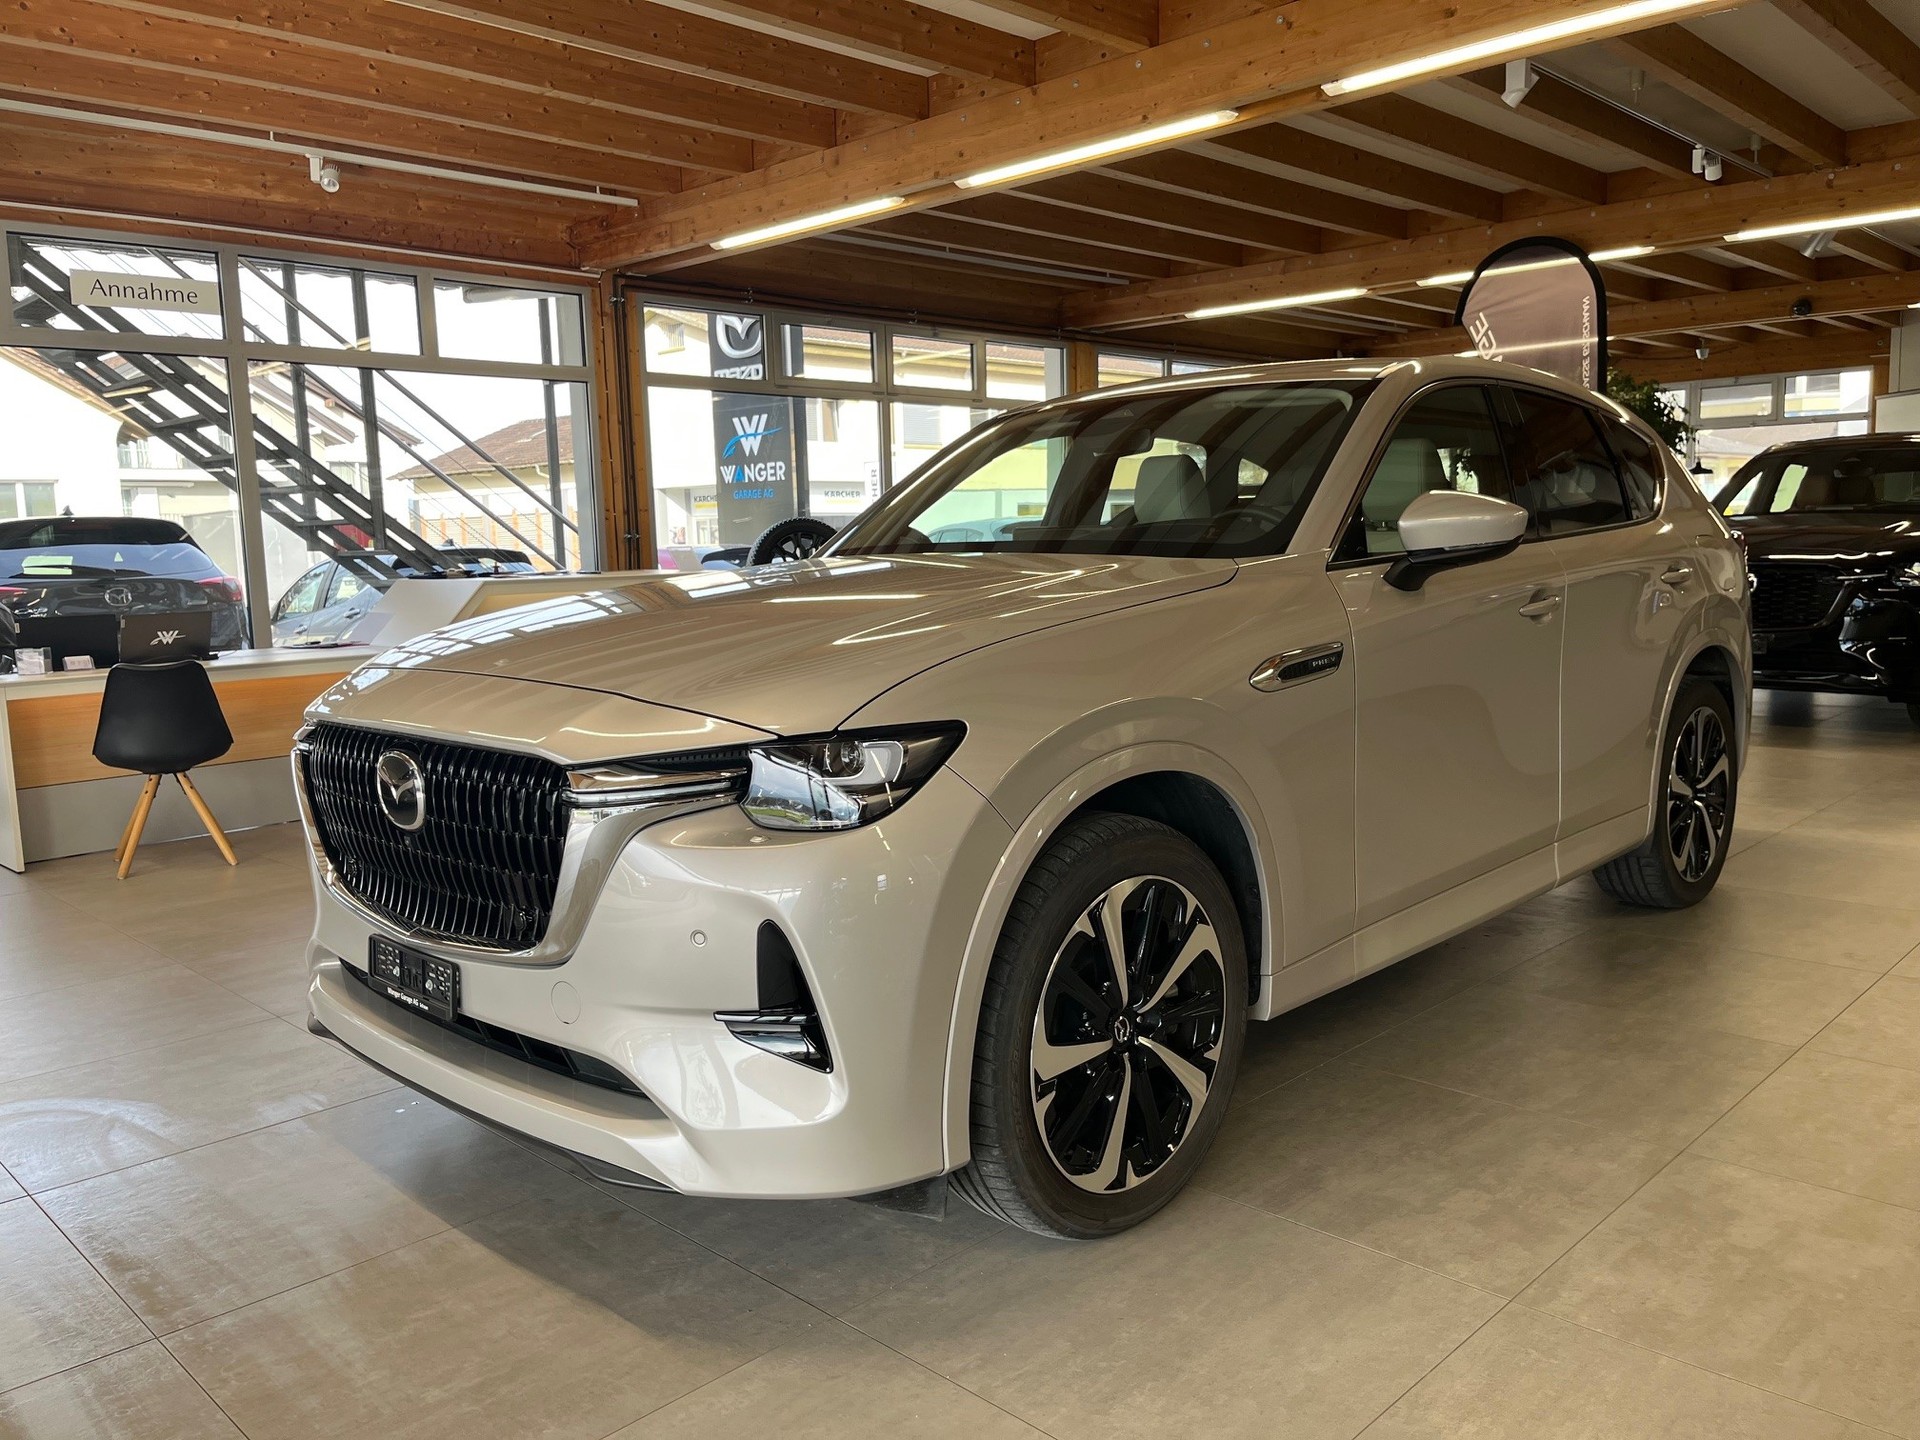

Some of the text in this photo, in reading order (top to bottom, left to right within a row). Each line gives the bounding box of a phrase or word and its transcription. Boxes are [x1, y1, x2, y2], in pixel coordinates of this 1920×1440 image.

[90, 278, 198, 304] Annahme
[720, 461, 786, 484] WANGER
[733, 487, 774, 499] GARAGE AG
[1312, 657, 1336, 667] PHEV
